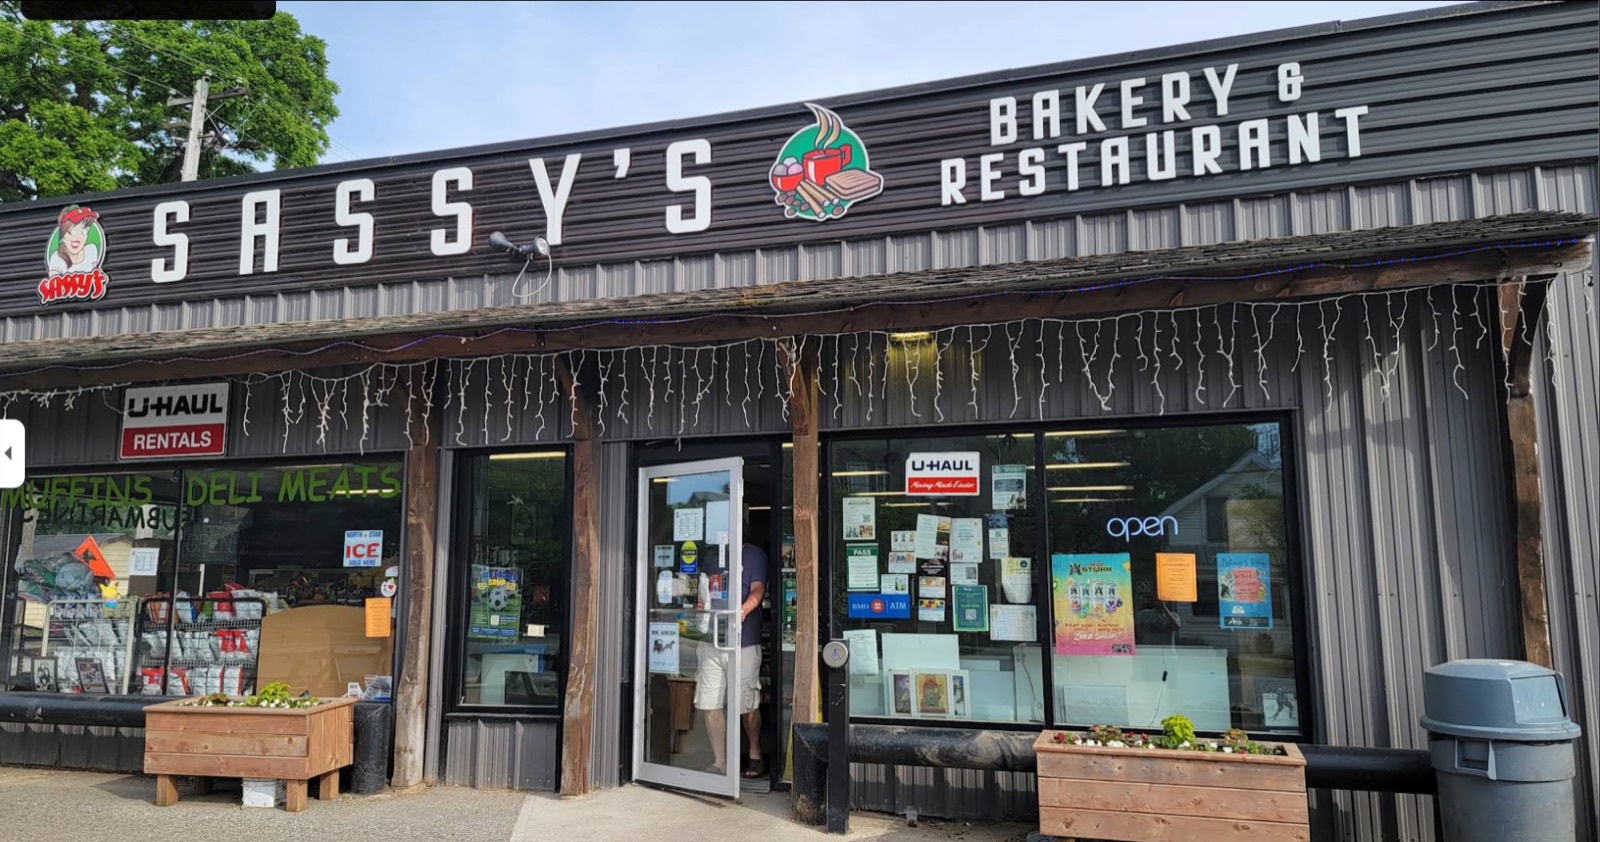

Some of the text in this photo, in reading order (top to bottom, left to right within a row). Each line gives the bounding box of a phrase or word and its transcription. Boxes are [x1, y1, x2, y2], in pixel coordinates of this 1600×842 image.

[989, 62, 1304, 147] BAKERY &
[940, 105, 1369, 206] RESTAURANT
[151, 138, 712, 284] SASSY'S
[128, 393, 223, 418] U-HAUL
[133, 430, 212, 451] RENTALS
[912, 460, 973, 471] U-HAUL
[2, 465, 401, 511] MUFFINS DELI MEATS
[911, 479, 975, 491] Moving Made Easier
[1106, 515, 1179, 543] open
[345, 542, 380, 559] ICE
[363, 558, 376, 566] HERE
[889, 602, 907, 610] ATM
